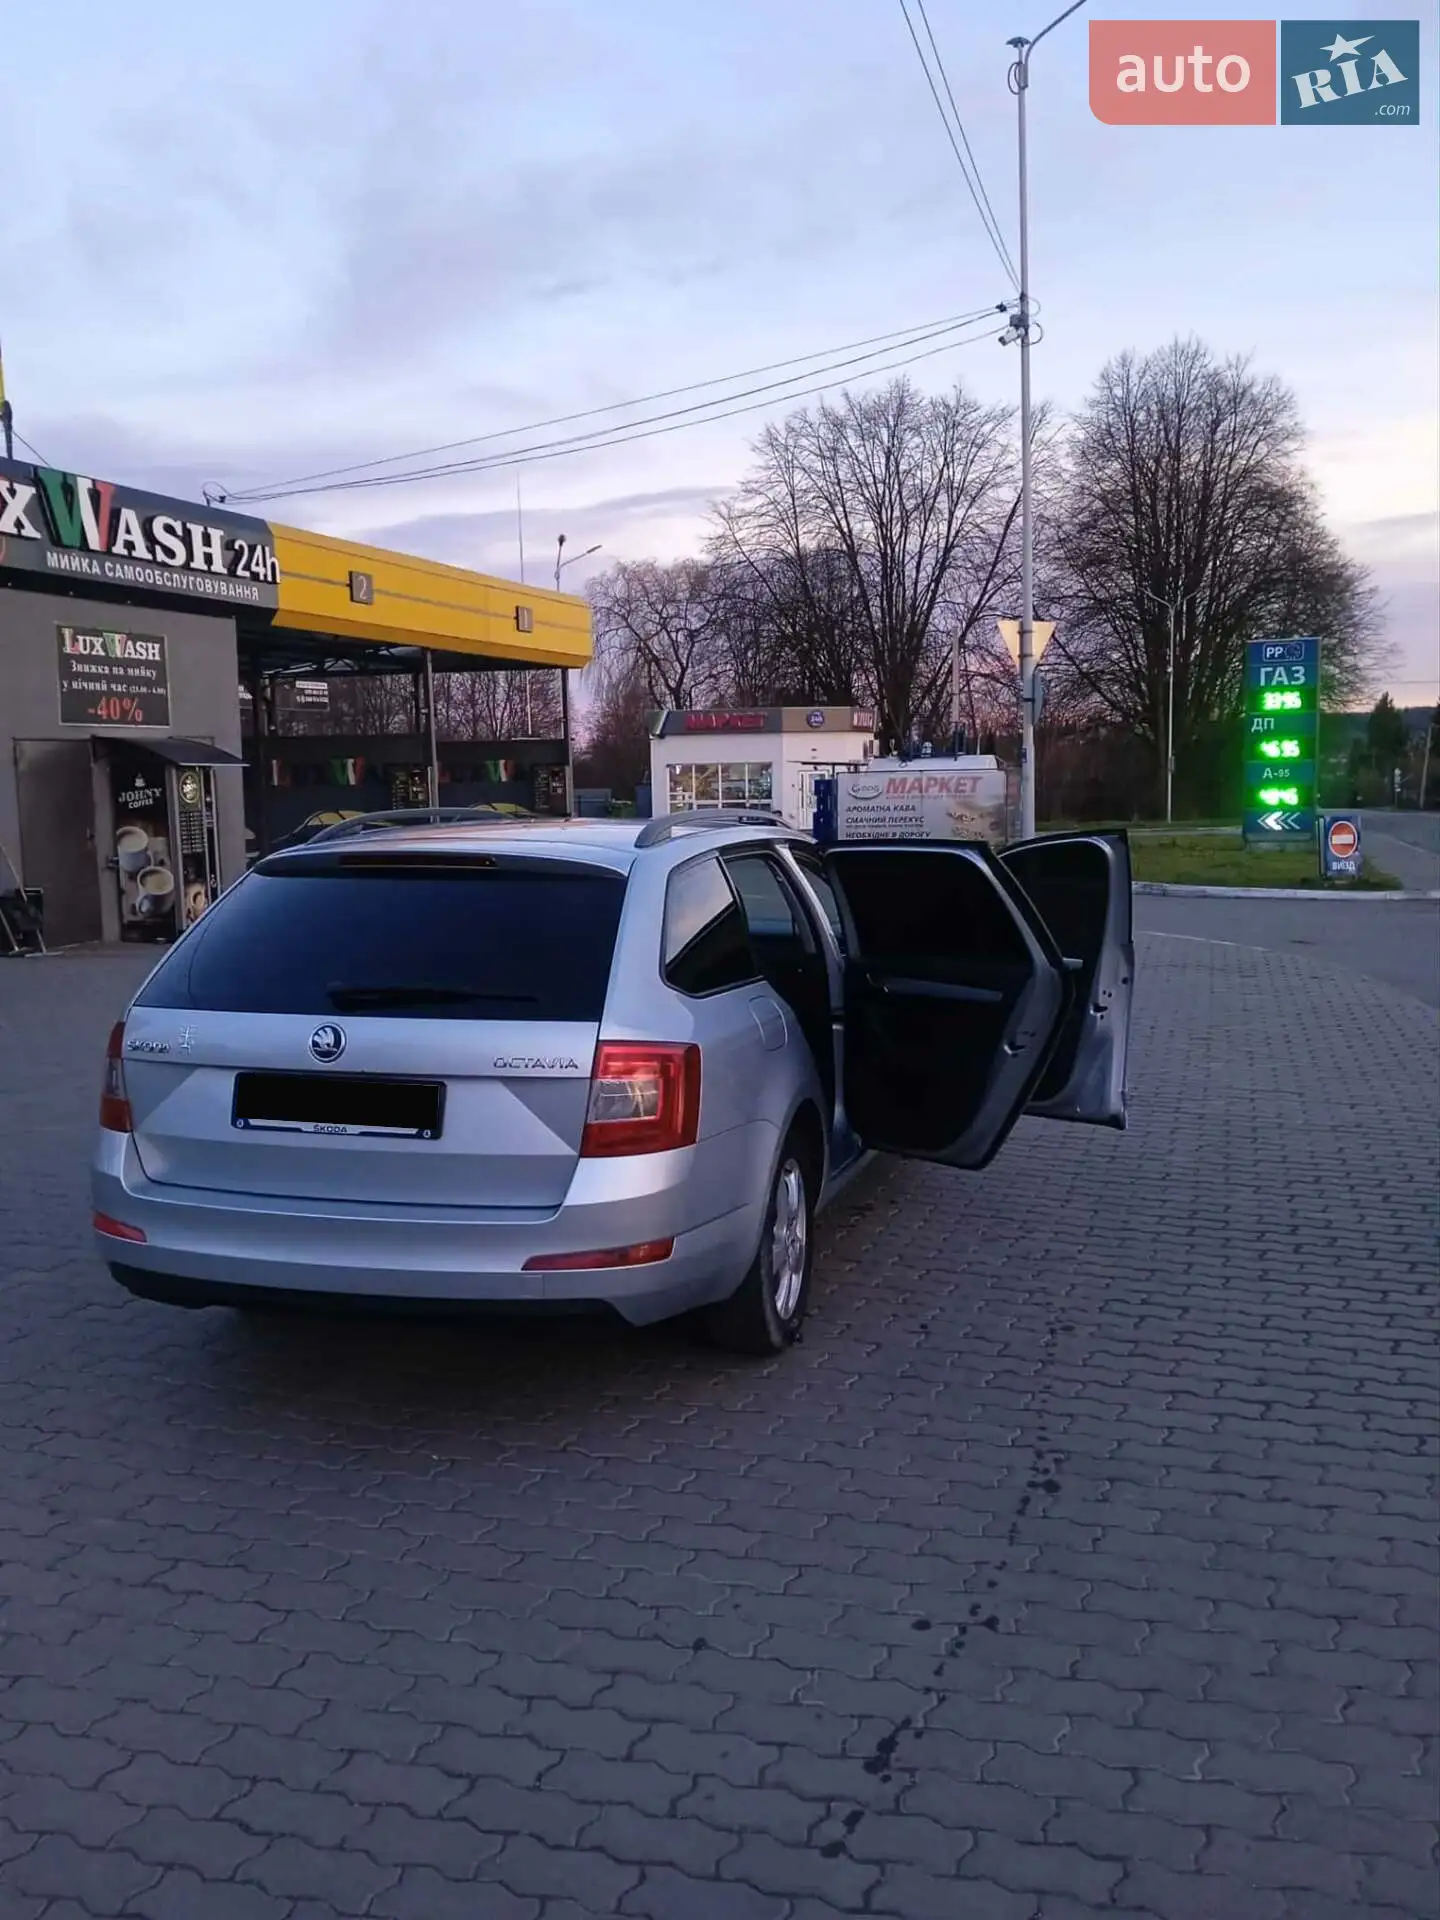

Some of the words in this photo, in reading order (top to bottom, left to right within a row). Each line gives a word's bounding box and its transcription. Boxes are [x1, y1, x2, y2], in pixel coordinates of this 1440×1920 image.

[234, 538, 281, 584] 24h
[46, 551, 101, 576] МИЙКА
[104, 559, 260, 601] САМООБСЛУГОВУВАННЯ
[358, 575, 367, 600] 2
[1260, 666, 1306, 686] ГАЗ
[110, 683, 127, 692] час
[87, 696, 143, 722] -40%
[1251, 717, 1275, 732] ДП
[885, 776, 983, 794] МАРКЕТ
[494, 1056, 579, 1070] OCTAVIA
